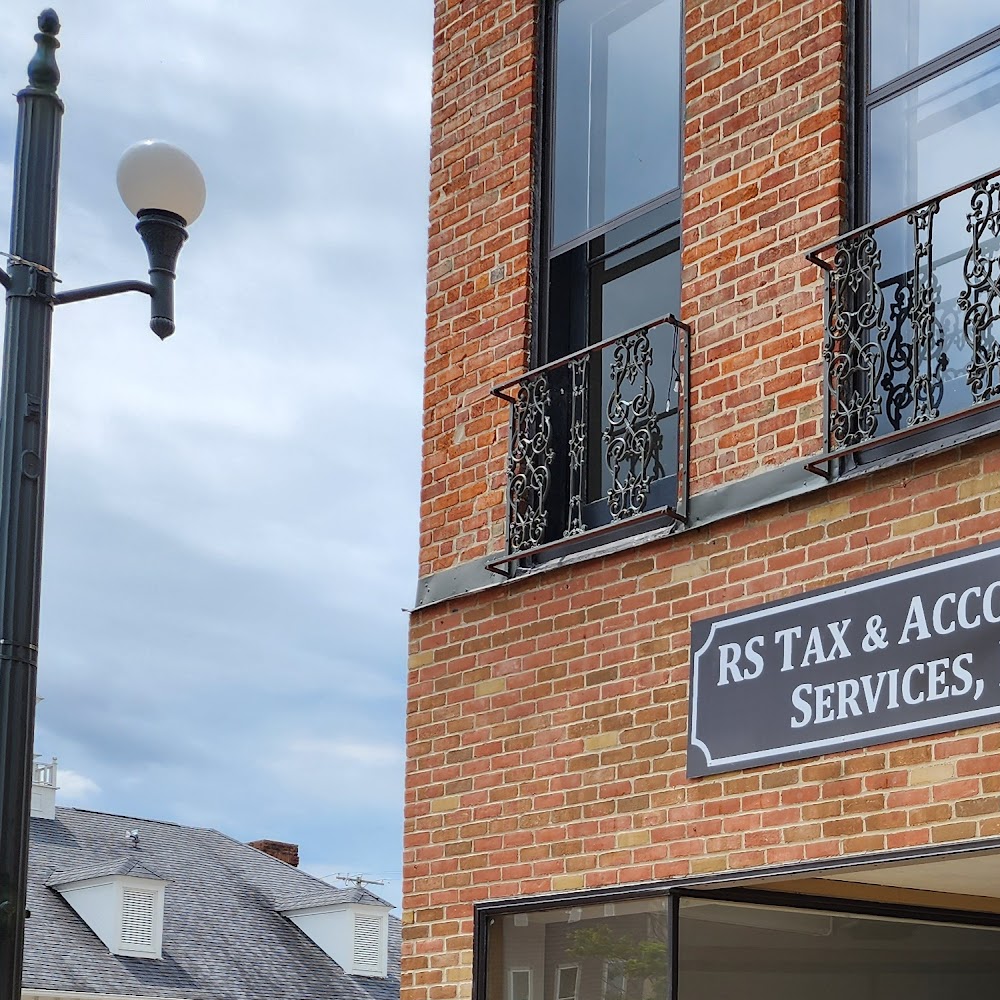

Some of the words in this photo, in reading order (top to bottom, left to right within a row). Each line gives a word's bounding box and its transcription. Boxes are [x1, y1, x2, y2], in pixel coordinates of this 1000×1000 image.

[717, 635, 765, 686] RS
[774, 618, 852, 672] TAX
[861, 614, 889, 652] &
[790, 653, 984, 728] SERVICES,
